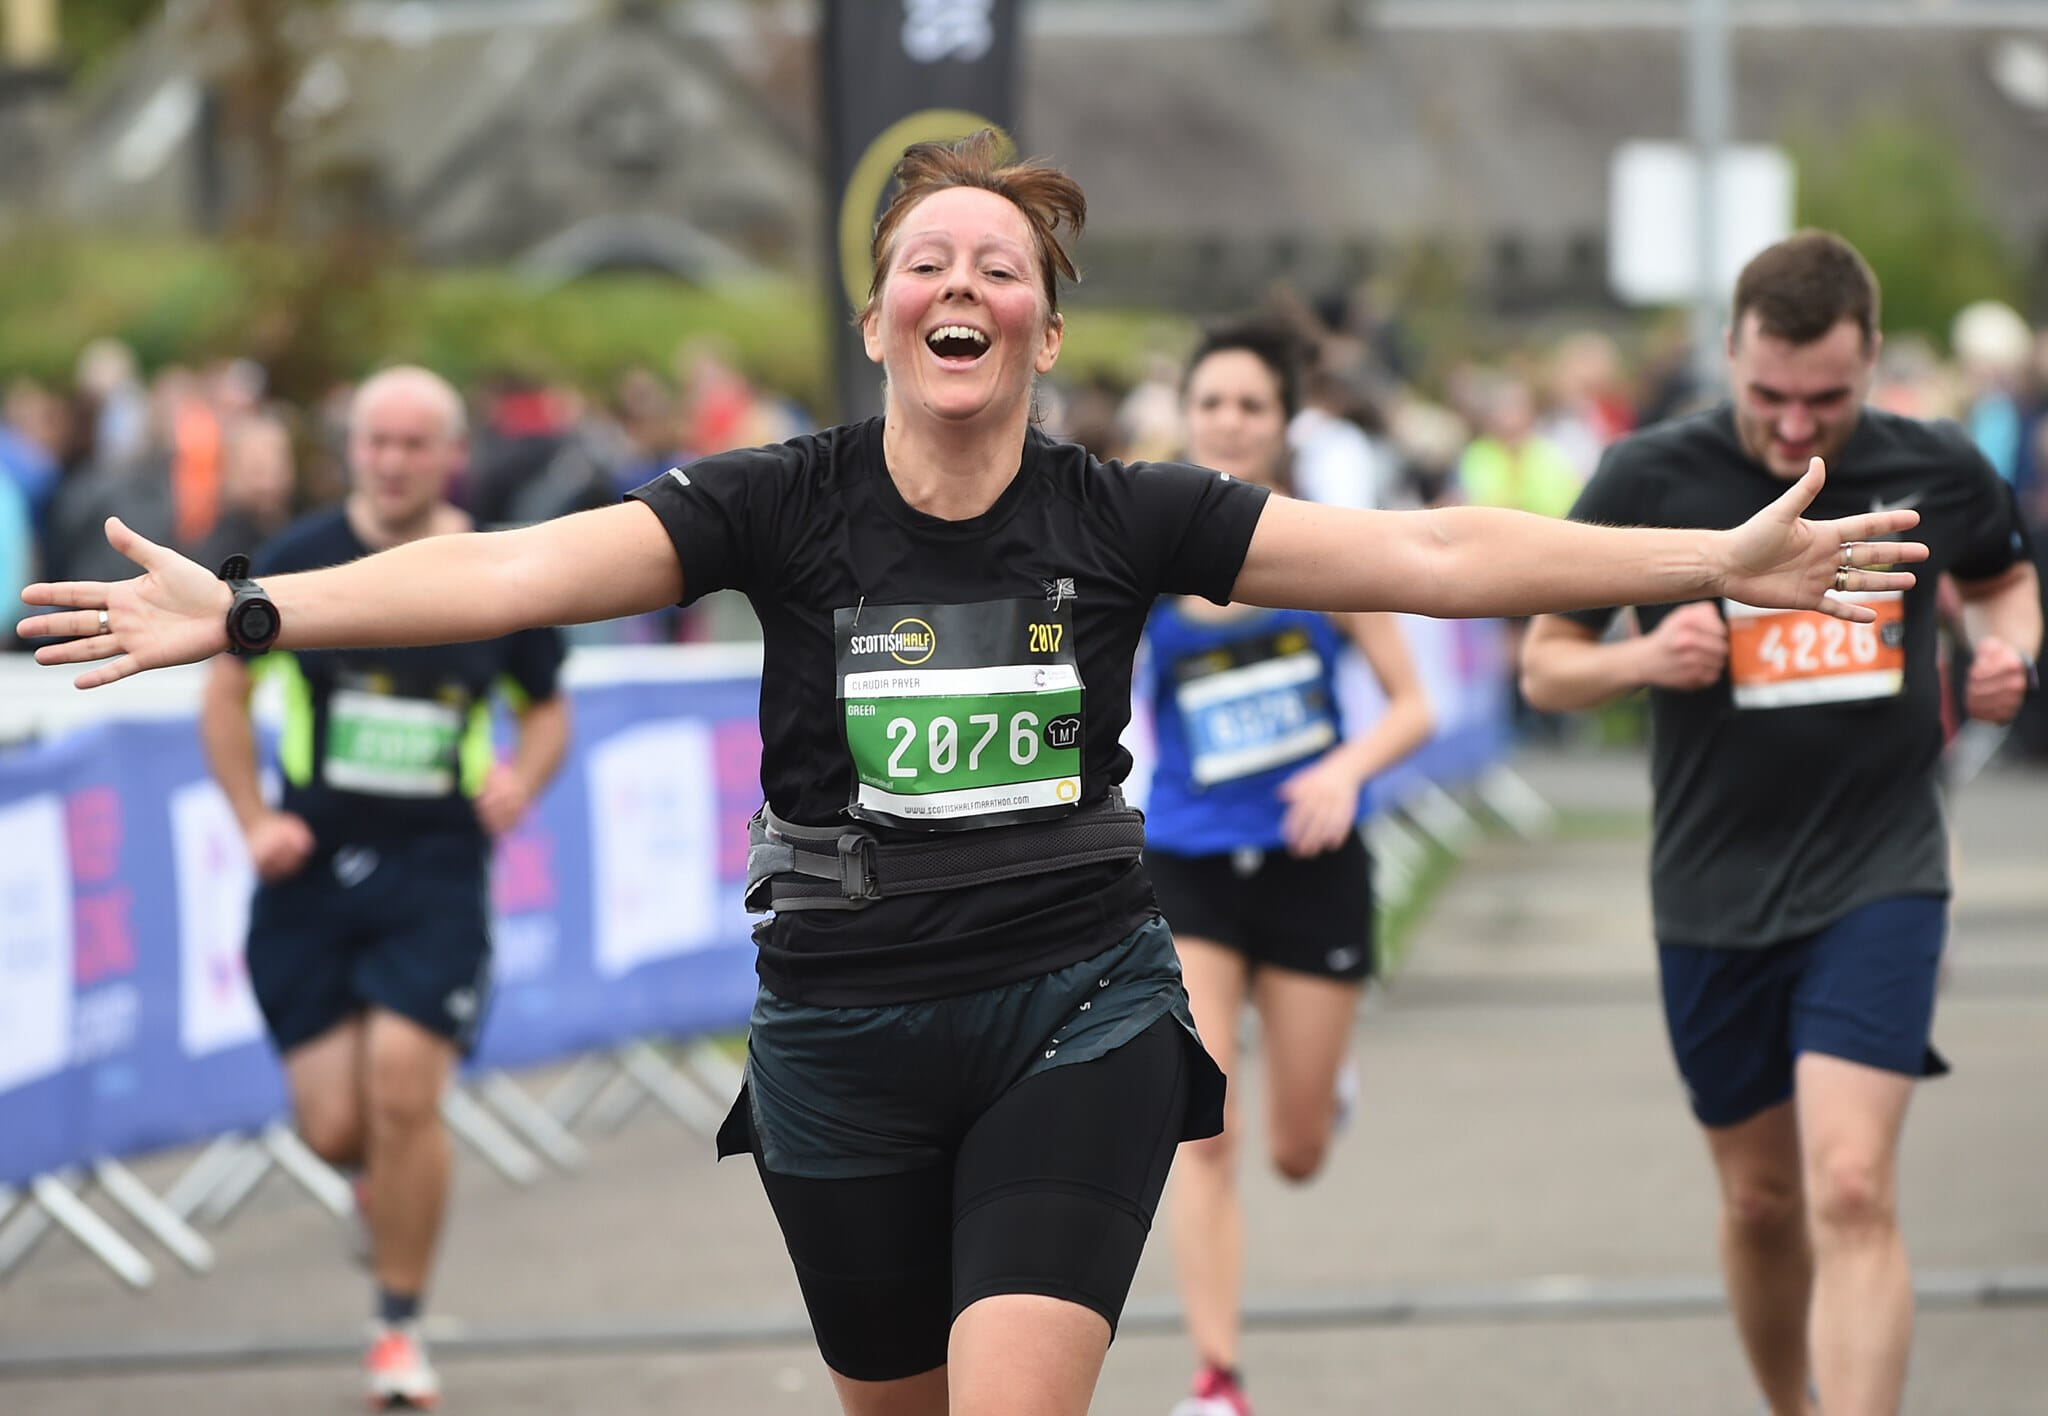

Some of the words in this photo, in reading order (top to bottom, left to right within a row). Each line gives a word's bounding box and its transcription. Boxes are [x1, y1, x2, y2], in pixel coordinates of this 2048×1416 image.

[1029, 624, 1064, 653] 2017
[1759, 619, 1879, 673] 4226
[852, 679, 889, 691] CLAUDIA
[892, 677, 921, 689] PAYER
[847, 704, 876, 716] GREEN
[886, 710, 1040, 778] 2076
[1059, 727, 1070, 742] M
